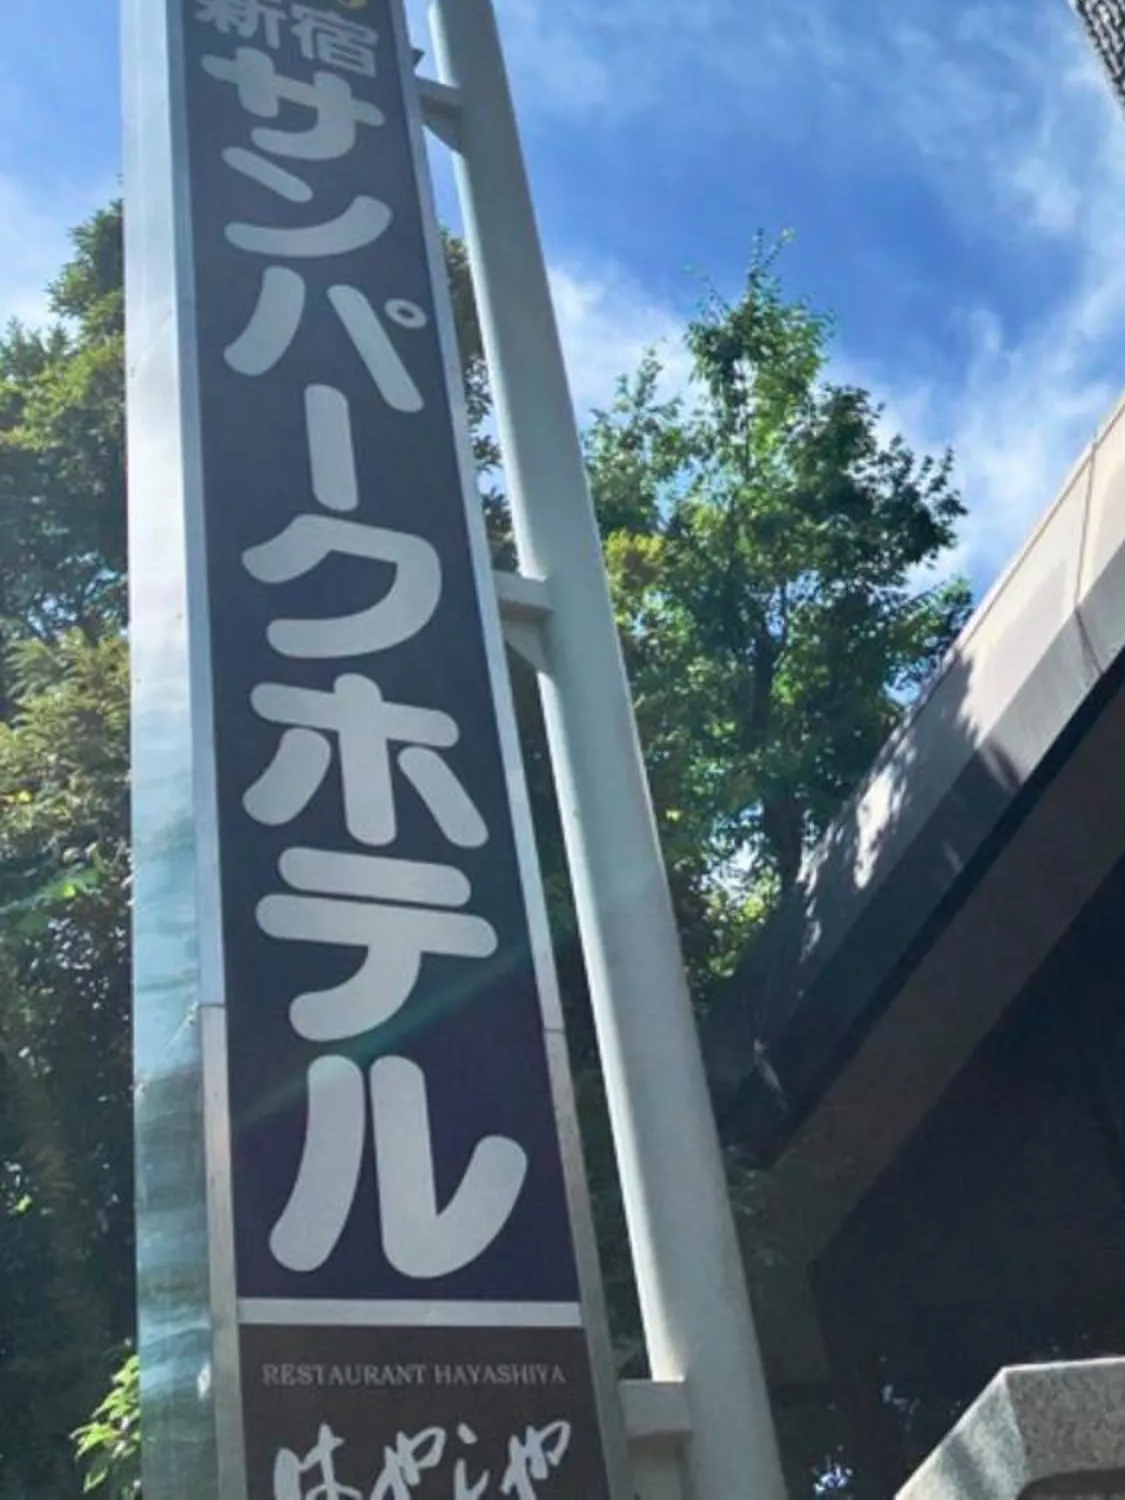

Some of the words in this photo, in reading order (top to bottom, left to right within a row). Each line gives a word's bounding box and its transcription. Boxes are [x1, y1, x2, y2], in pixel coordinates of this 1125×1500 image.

[200, 46, 529, 1279] サンパークホテル
[261, 1363, 427, 1386] RESTAURANT
[433, 1363, 567, 1385] HAYASHIYA
